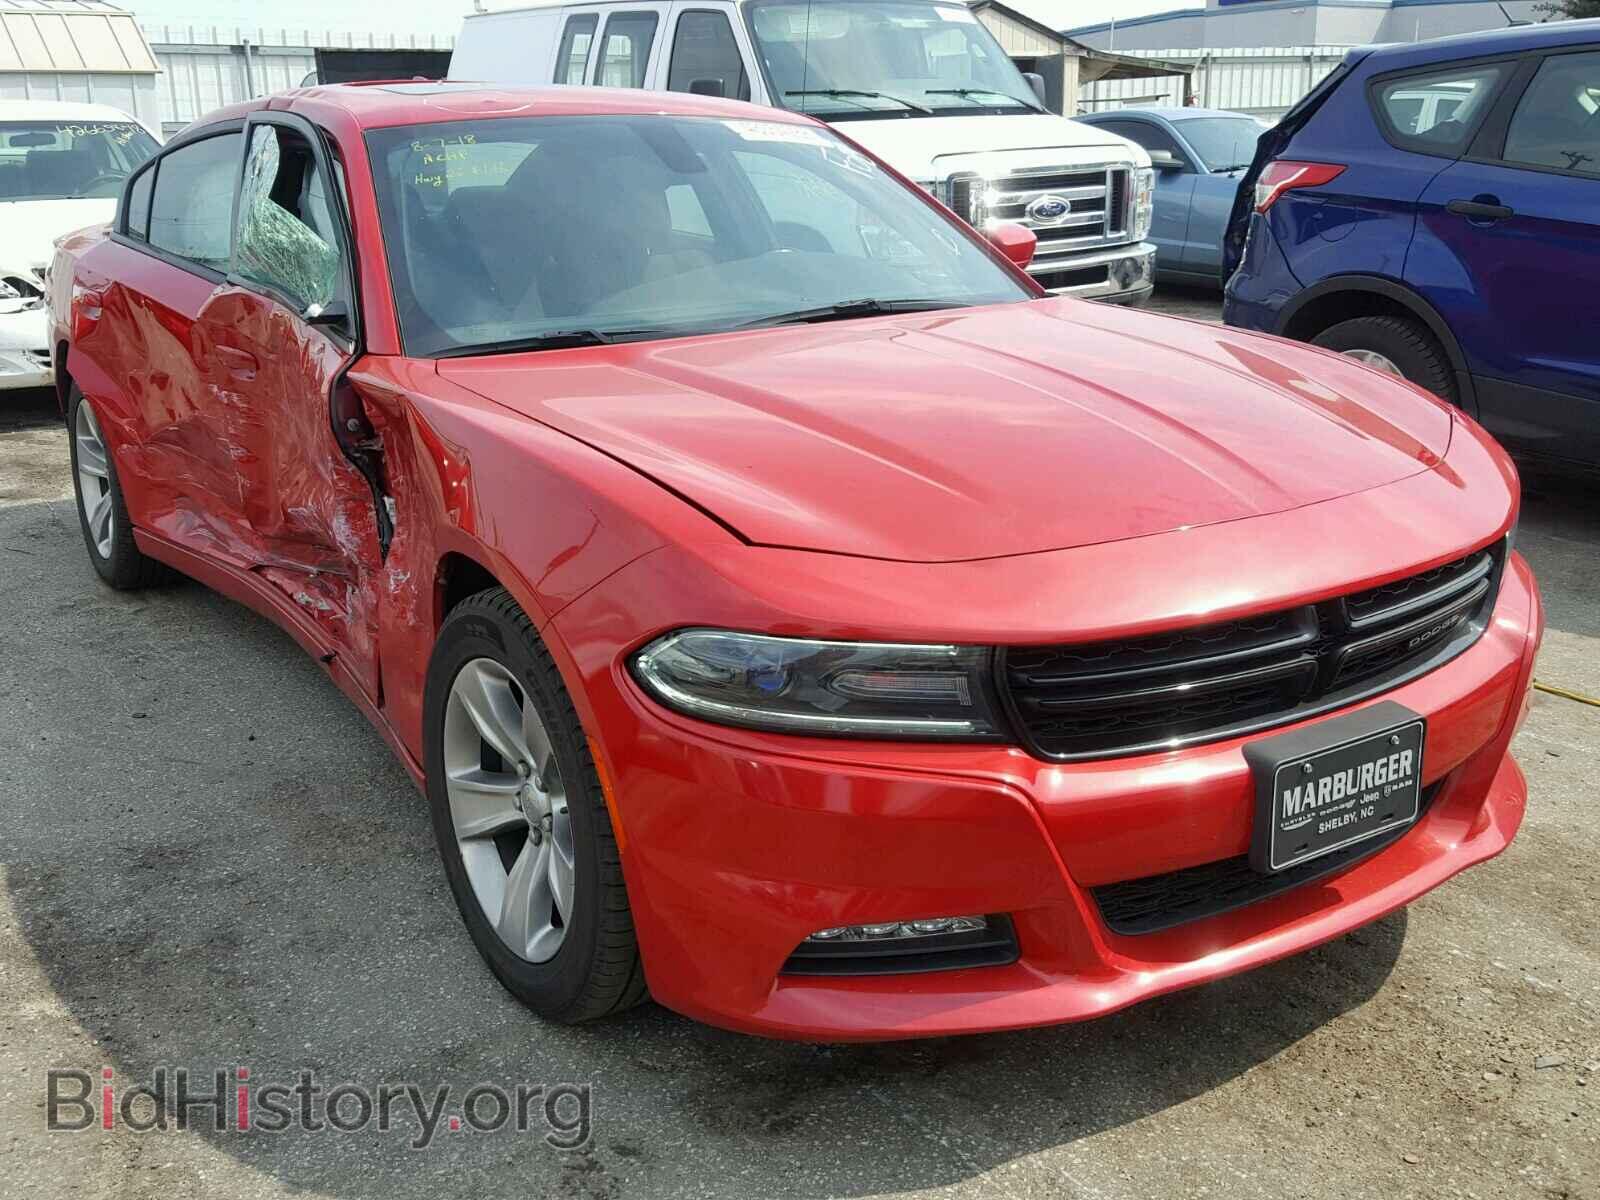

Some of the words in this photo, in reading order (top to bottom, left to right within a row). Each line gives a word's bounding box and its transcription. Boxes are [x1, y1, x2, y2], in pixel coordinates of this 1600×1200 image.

[1282, 749, 1413, 818] MARBURGER
[1318, 812, 1358, 834] SHELBY,
[1360, 805, 1375, 820] NC
